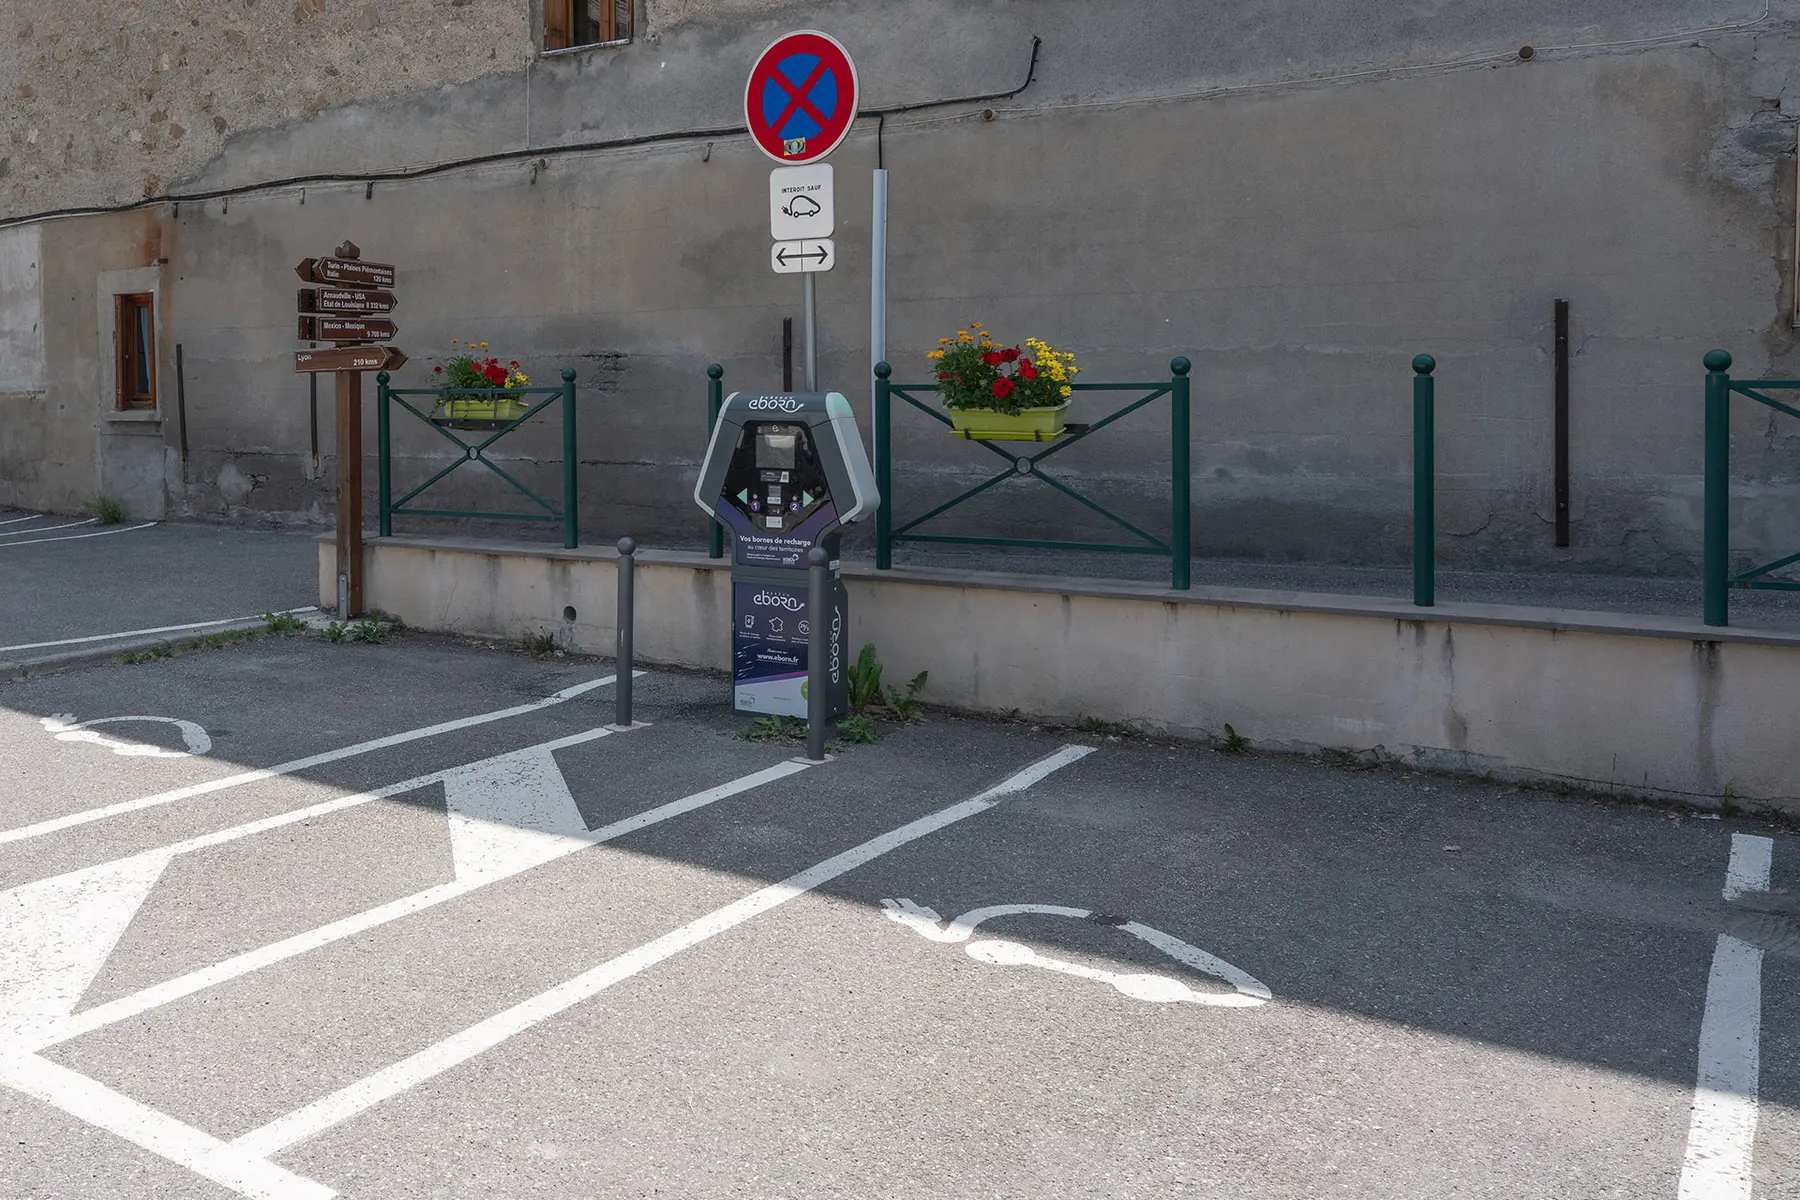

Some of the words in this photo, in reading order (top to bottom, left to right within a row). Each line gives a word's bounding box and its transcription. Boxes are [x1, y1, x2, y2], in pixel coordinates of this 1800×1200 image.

[345, 322, 365, 330] Mexique
[297, 354, 312, 362] Lyon
[784, 538, 812, 547] recharge
[756, 654, 799, 664] www.eborn.fr
